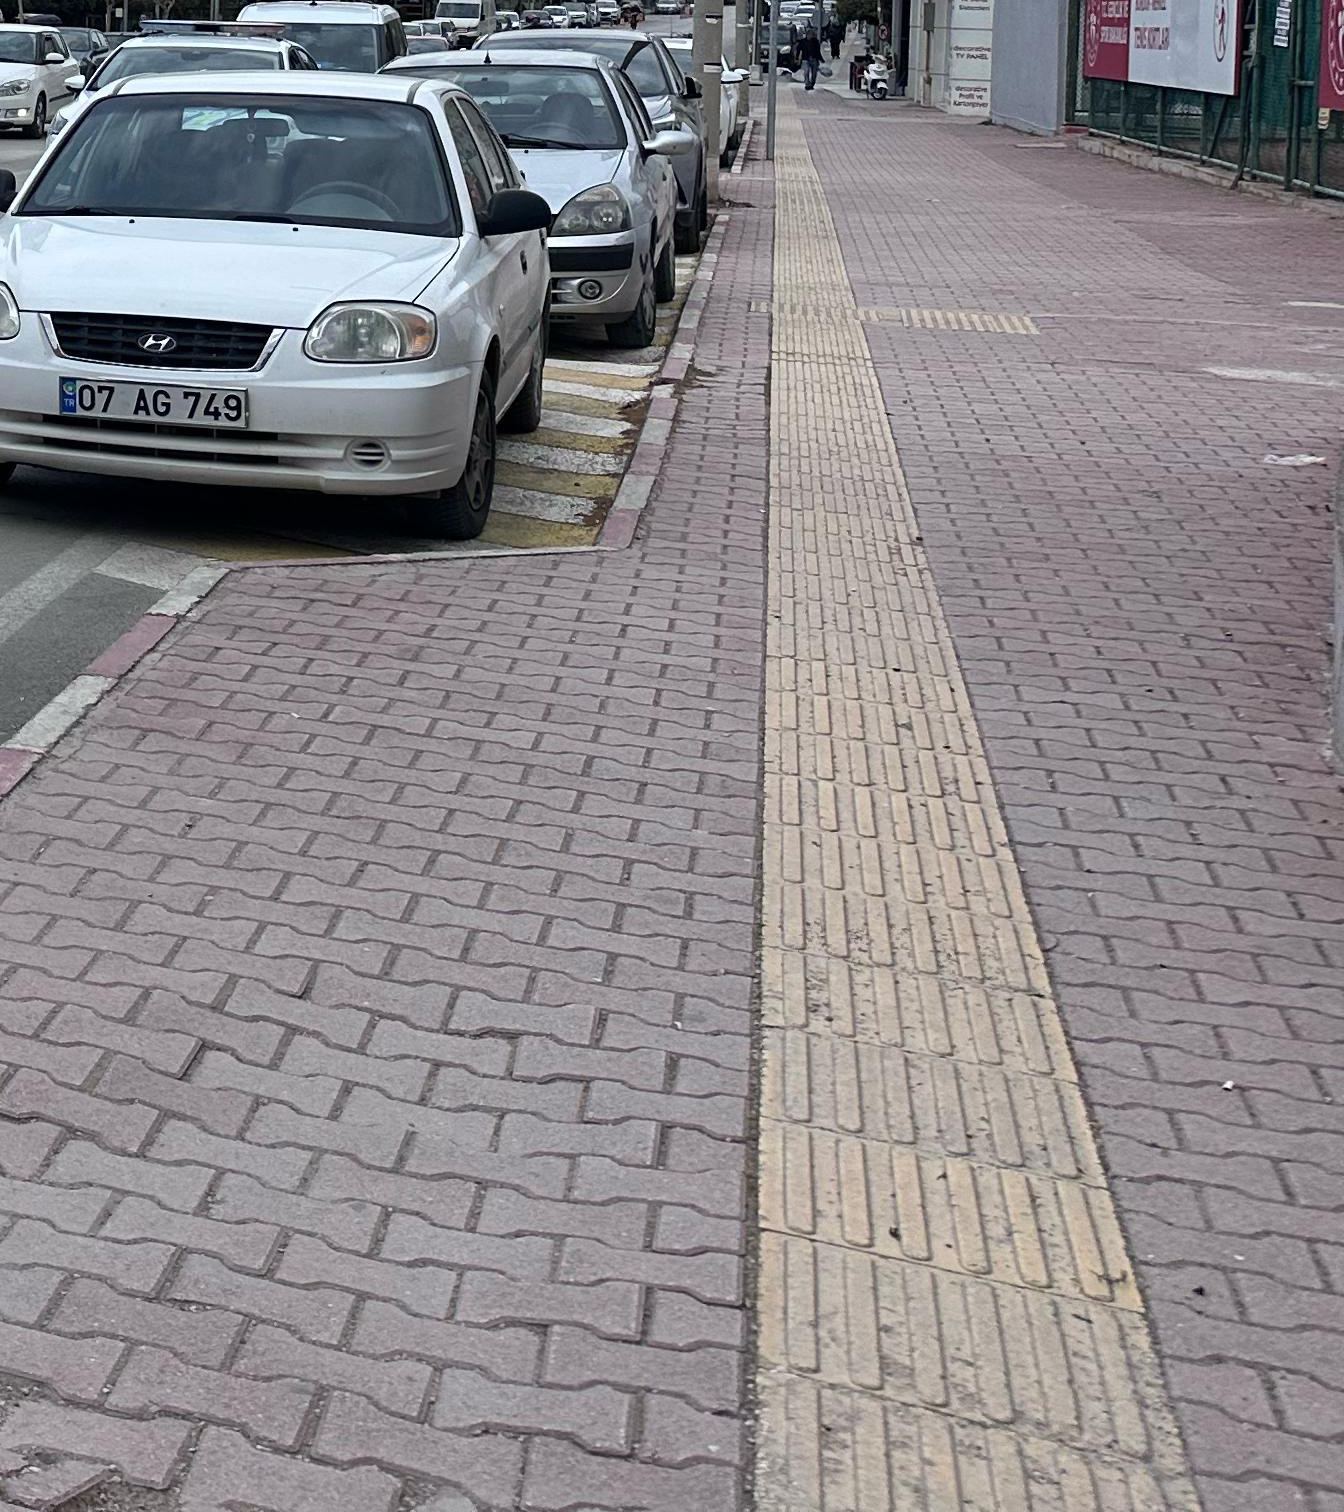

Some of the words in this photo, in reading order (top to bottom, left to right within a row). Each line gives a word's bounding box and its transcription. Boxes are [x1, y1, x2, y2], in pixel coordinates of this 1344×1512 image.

[64, 398, 75, 407] TR
[78, 384, 115, 413] 07
[133, 388, 171, 417] AG
[183, 391, 242, 422] 749
